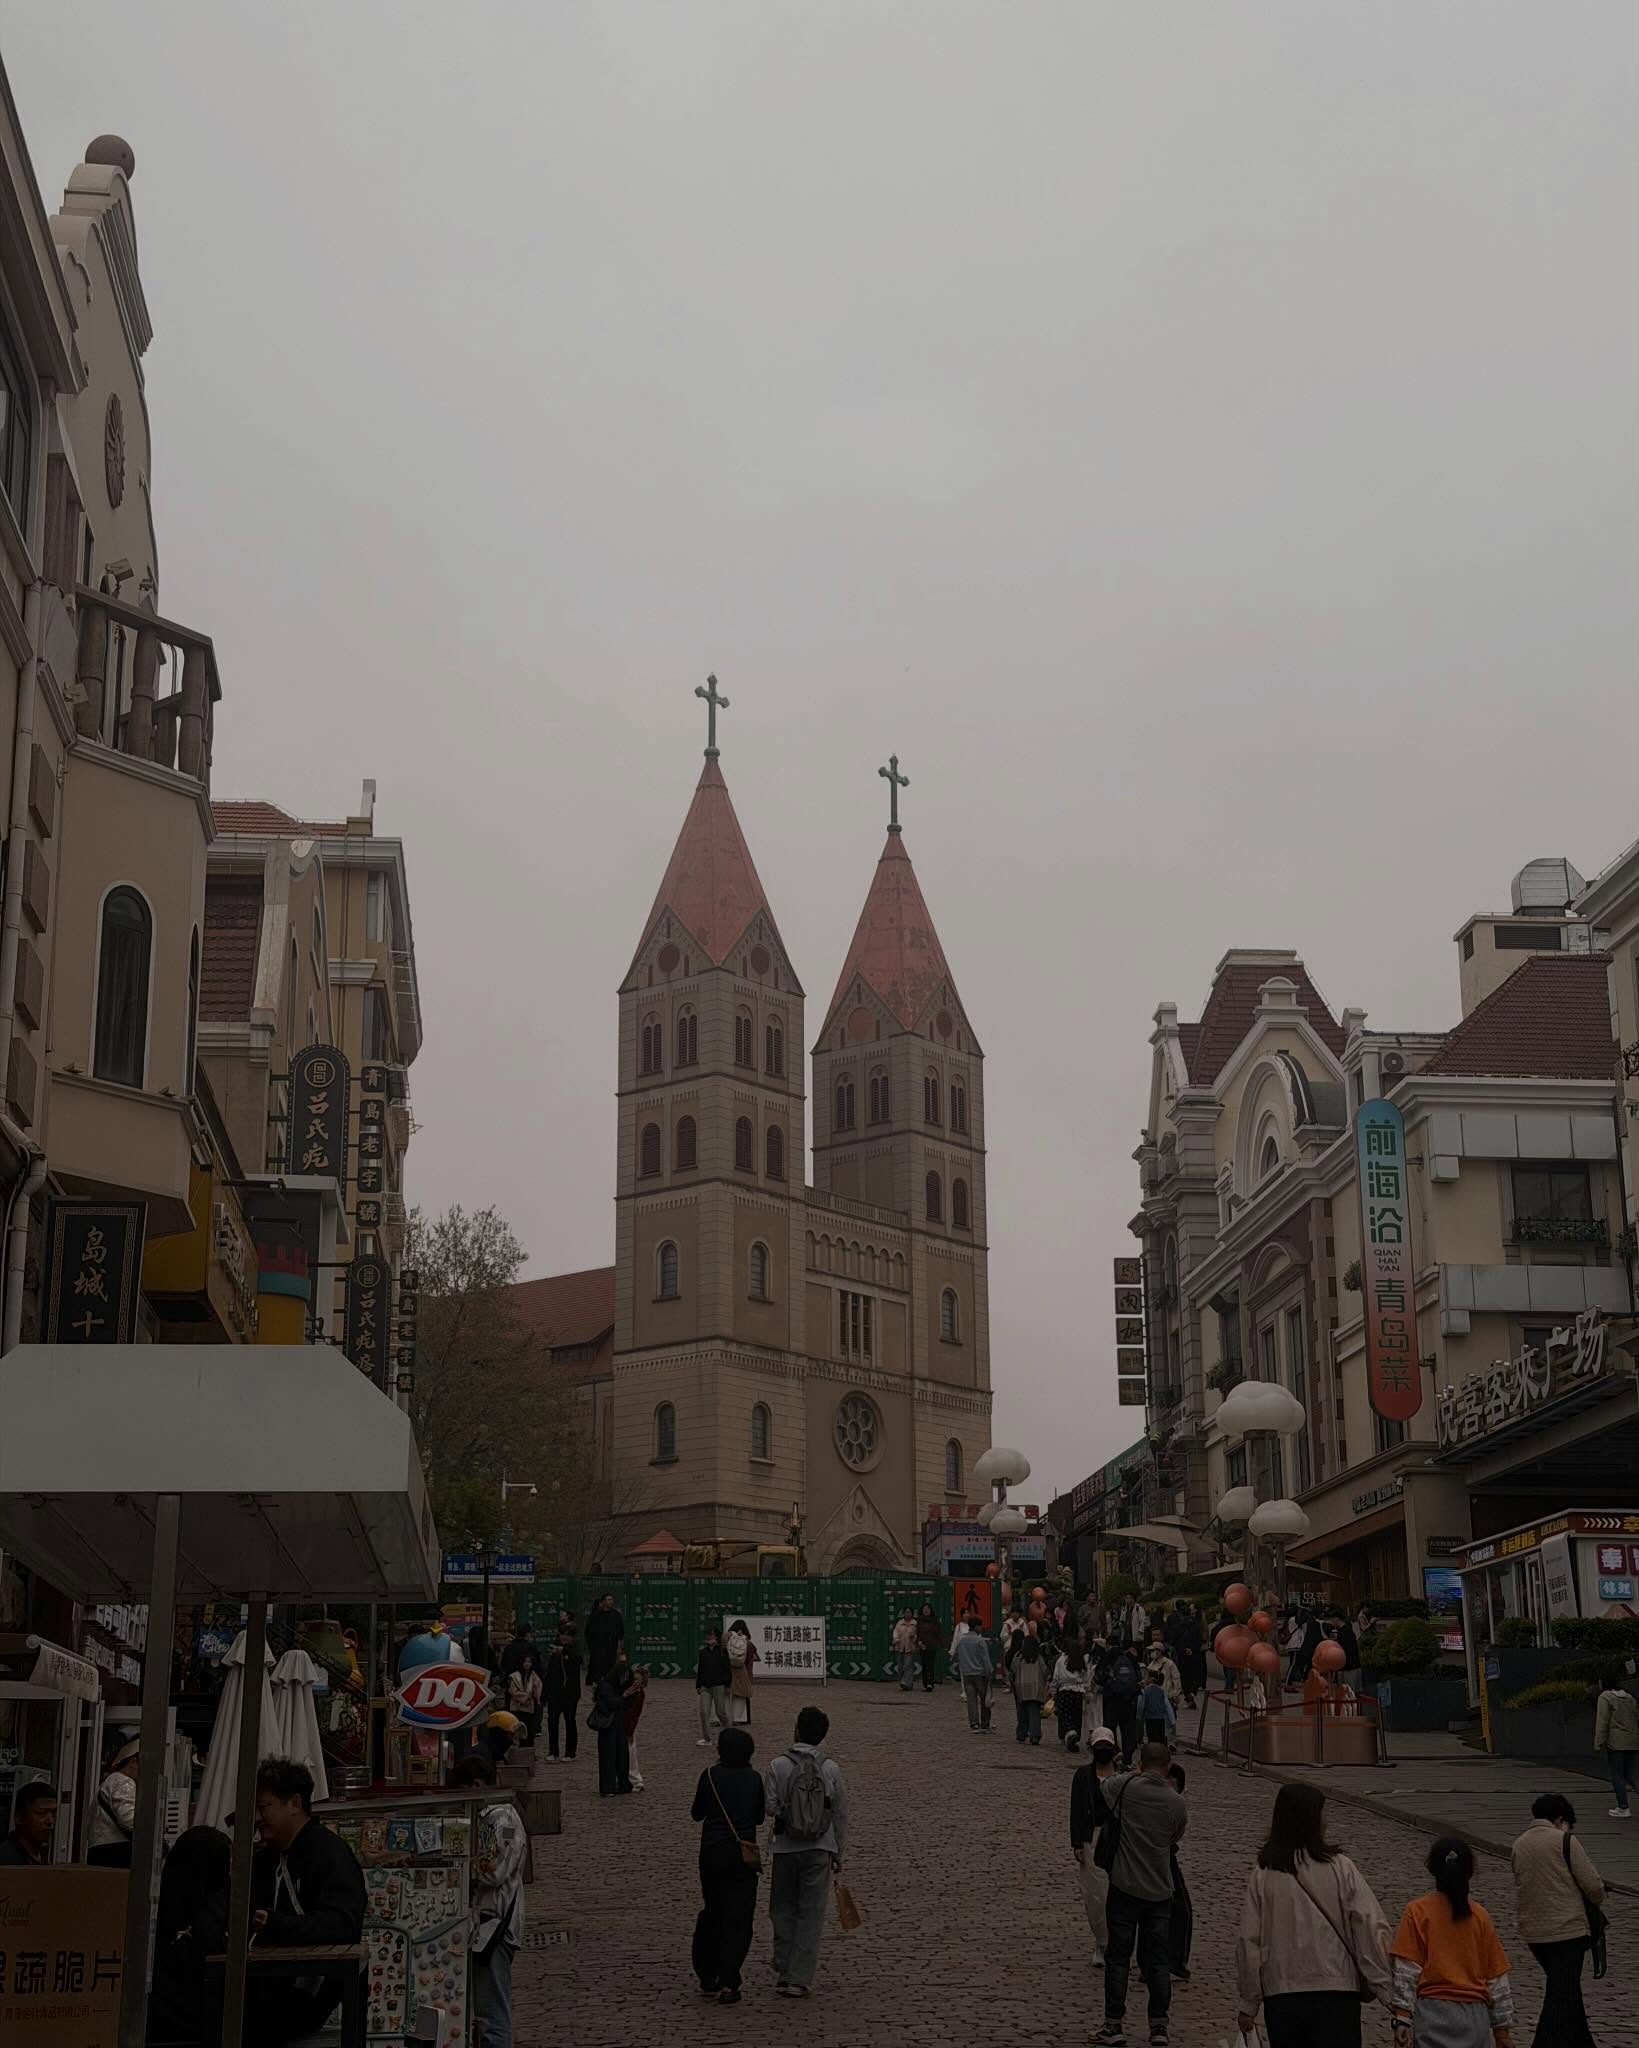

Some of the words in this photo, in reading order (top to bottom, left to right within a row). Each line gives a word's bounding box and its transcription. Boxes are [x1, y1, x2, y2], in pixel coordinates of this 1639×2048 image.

[302, 1091, 329, 1176] 吕氏疙
[1365, 1119, 1403, 1243] 前海沿
[1378, 1257, 1398, 1265] HAI
[1375, 1278, 1413, 1392] 青岛菜
[763, 1625, 821, 1643] 前方道路施工
[764, 1650, 822, 1669] 车辆减速慢行
[414, 1677, 476, 1713] DQ
[0, 1950, 122, 1994] 蔬脆片
